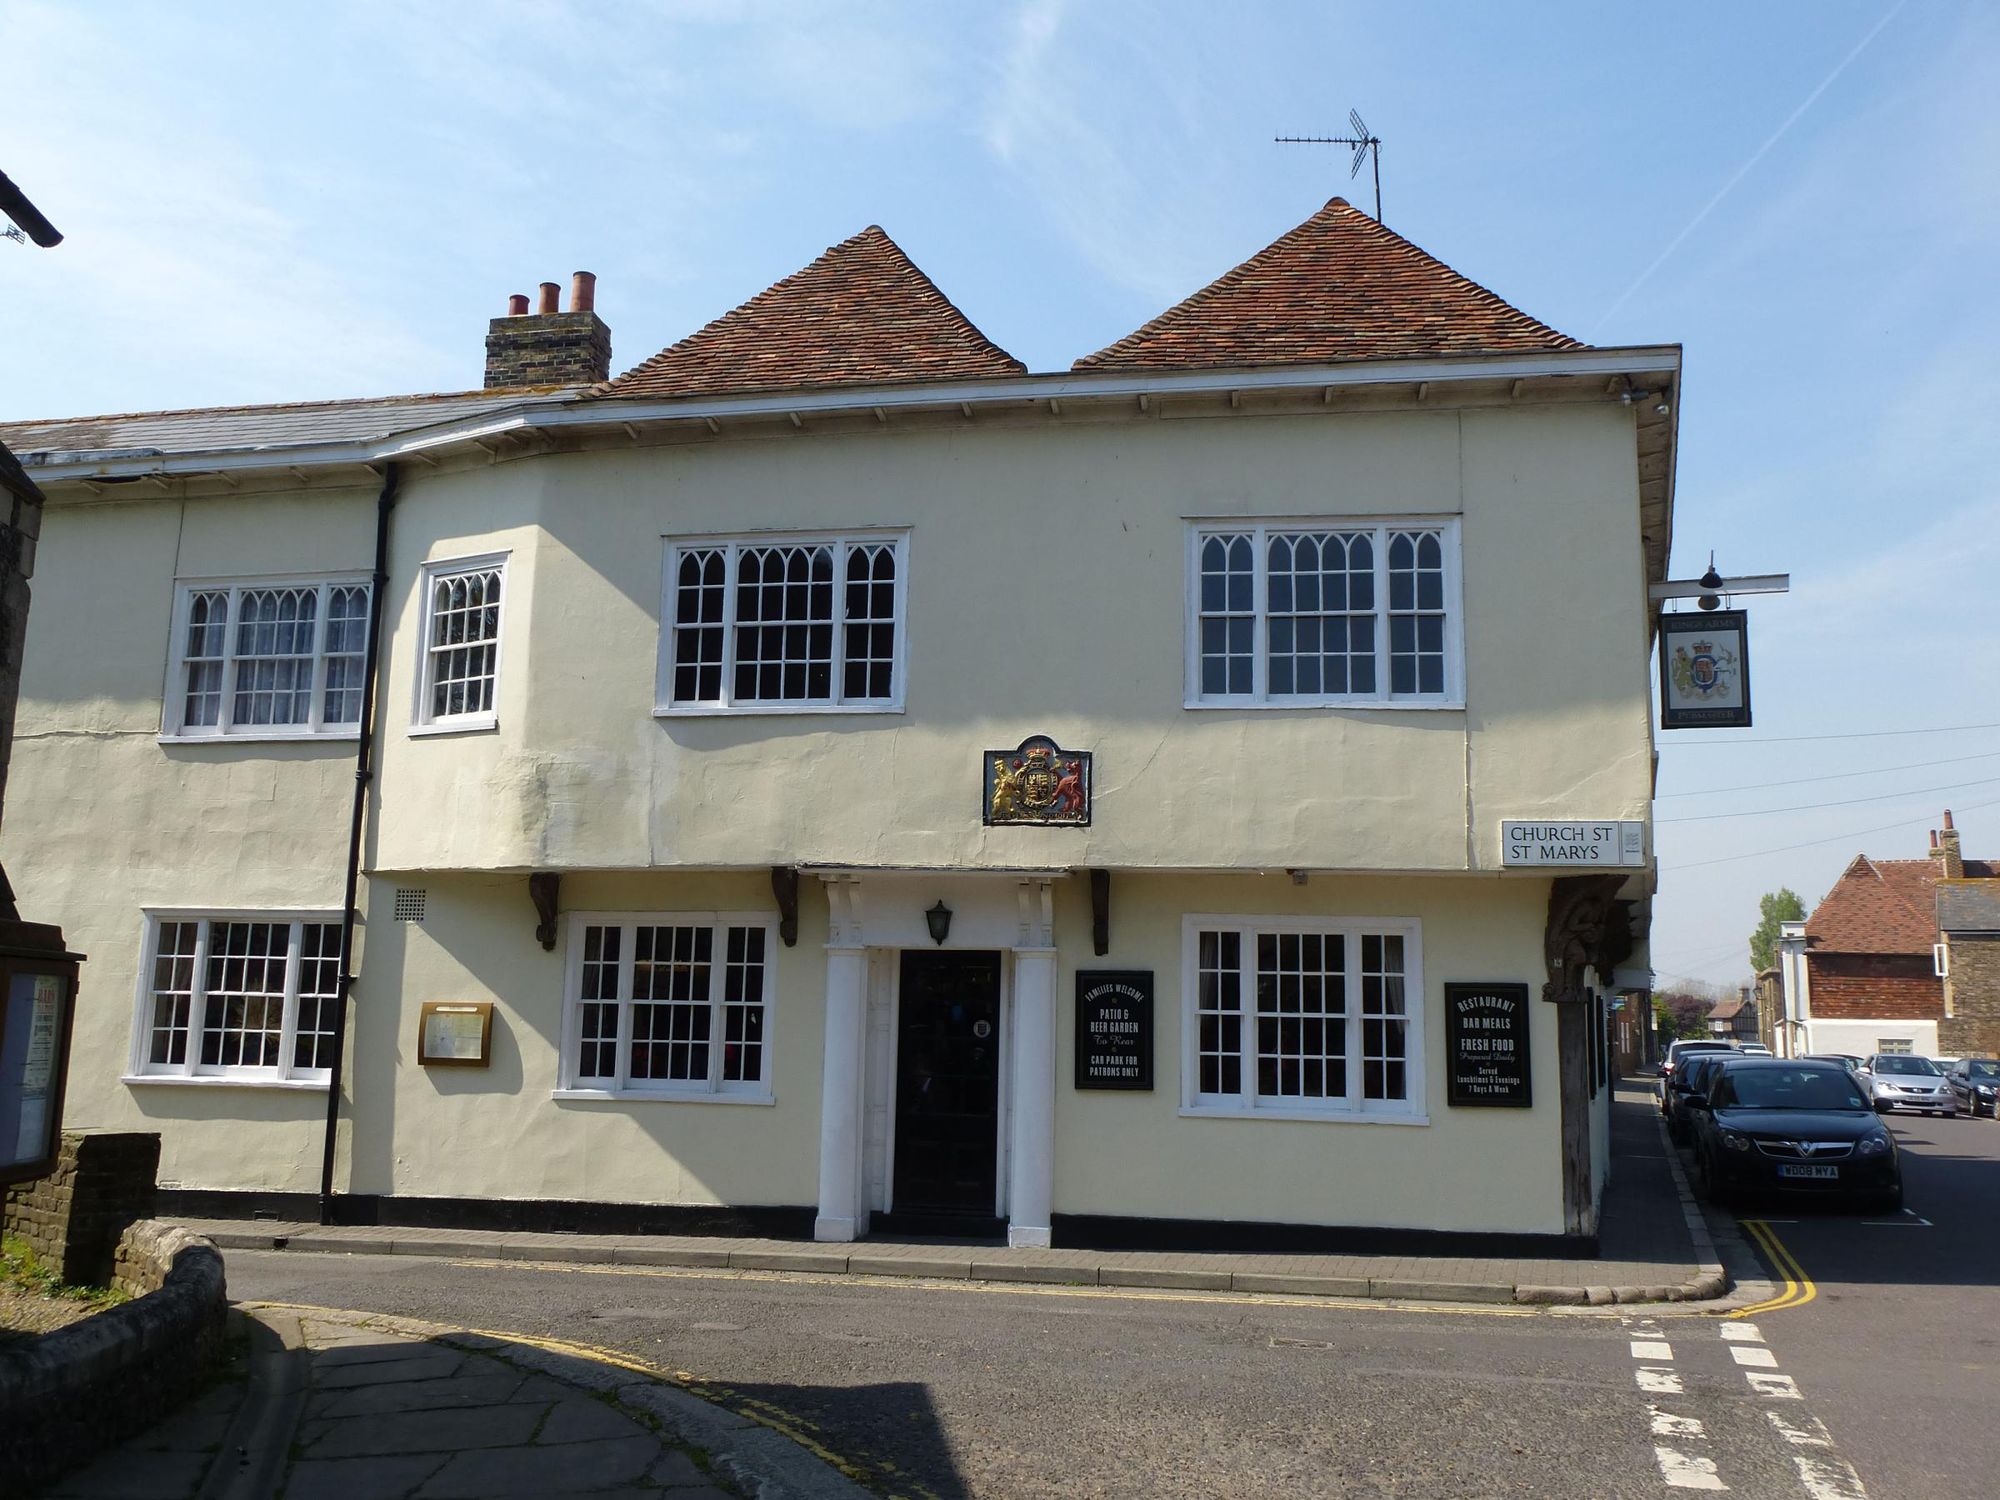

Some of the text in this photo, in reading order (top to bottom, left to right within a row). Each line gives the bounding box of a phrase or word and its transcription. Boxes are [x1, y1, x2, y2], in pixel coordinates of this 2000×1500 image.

[1511, 827, 1612, 841] CHURCH ST
[1511, 845, 1599, 859] ST MARYS
[1084, 983, 1145, 1003] FAMILIES WELCOME
[1456, 996, 1516, 1013] RESTAURANT
[1099, 1008, 1122, 1020] PATIO
[1090, 1021, 1139, 1033] BEER GARDEN
[1463, 1017, 1511, 1029] BAR MEALS
[1461, 1038, 1514, 1051] FRESH FOOD
[1091, 1055, 1138, 1065] CAR PARK FOR
[1089, 1067, 1139, 1077] PATRONS ONLY
[1479, 1067, 1498, 1075] Served
[1495, 1075, 1520, 1085] Evenings
[1473, 1084, 1487, 1094] Days
[1494, 1085, 1509, 1093] Week
[1815, 1166, 1837, 1177] MYA
